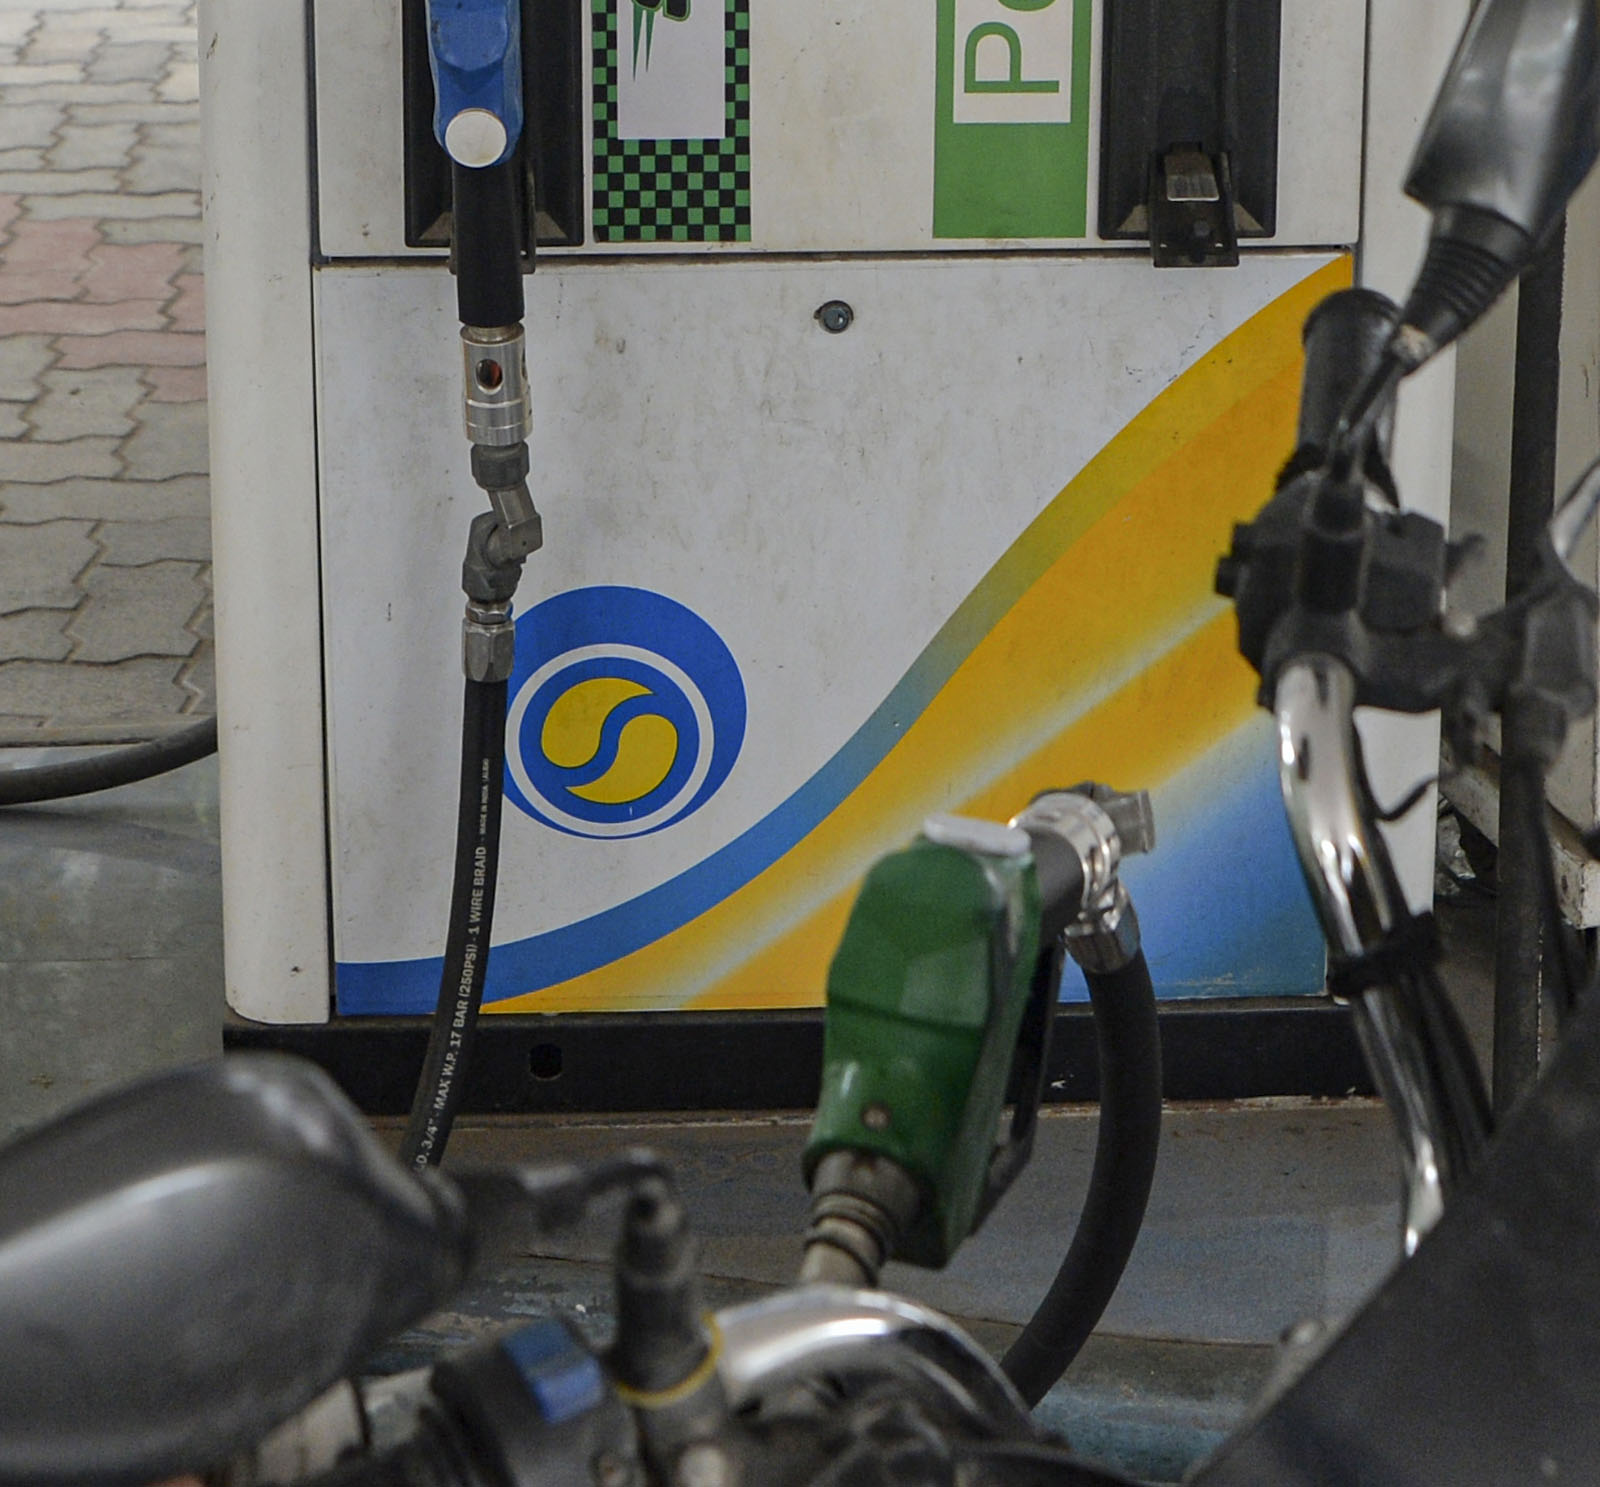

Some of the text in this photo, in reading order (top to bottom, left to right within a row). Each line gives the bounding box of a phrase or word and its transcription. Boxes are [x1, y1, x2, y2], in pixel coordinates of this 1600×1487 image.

[473, 847, 487, 886] BRAID
[469, 889, 484, 924] WIRE
[468, 925, 480, 935] 1
[458, 943, 478, 998] (250PSI)
[453, 999, 469, 1028] BAR
[450, 1031, 462, 1048] 17
[442, 1052, 459, 1076] W.P.
[433, 1075, 450, 1110] MAX
